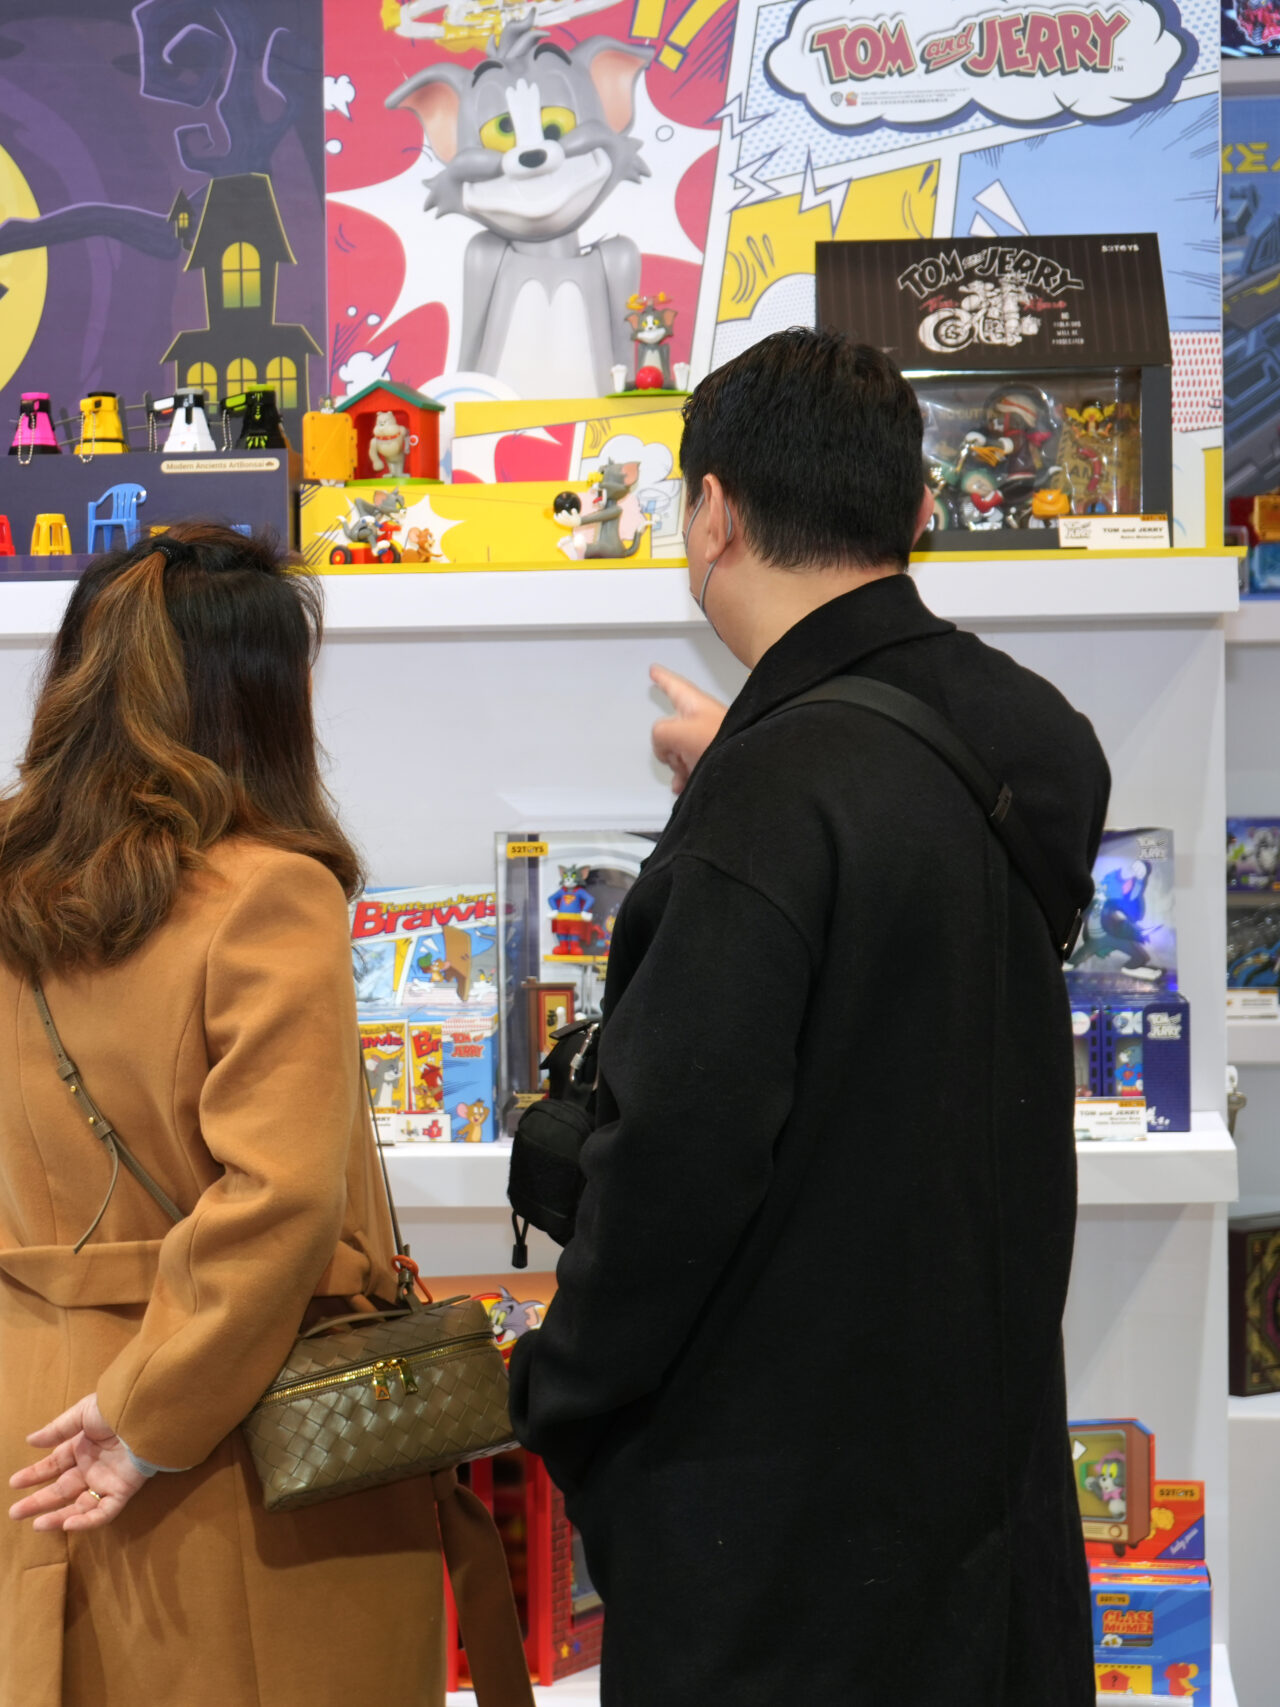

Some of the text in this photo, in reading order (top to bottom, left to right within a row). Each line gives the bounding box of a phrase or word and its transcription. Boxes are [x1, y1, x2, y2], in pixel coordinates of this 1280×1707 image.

[811, 19, 917, 83] TOM
[923, 23, 976, 73] and
[962, 10, 1130, 77] JERRY
[897, 248, 964, 299] TOM
[974, 246, 1085, 296] JERRY
[511, 845, 544, 854] 52TOYS
[352, 900, 512, 939] Brawls
[412, 1030, 442, 1058] Br
[451, 1045, 484, 1058] JERRY
[1102, 1610, 1153, 1624] CLASS
[1103, 1622, 1153, 1635] MOMEN
